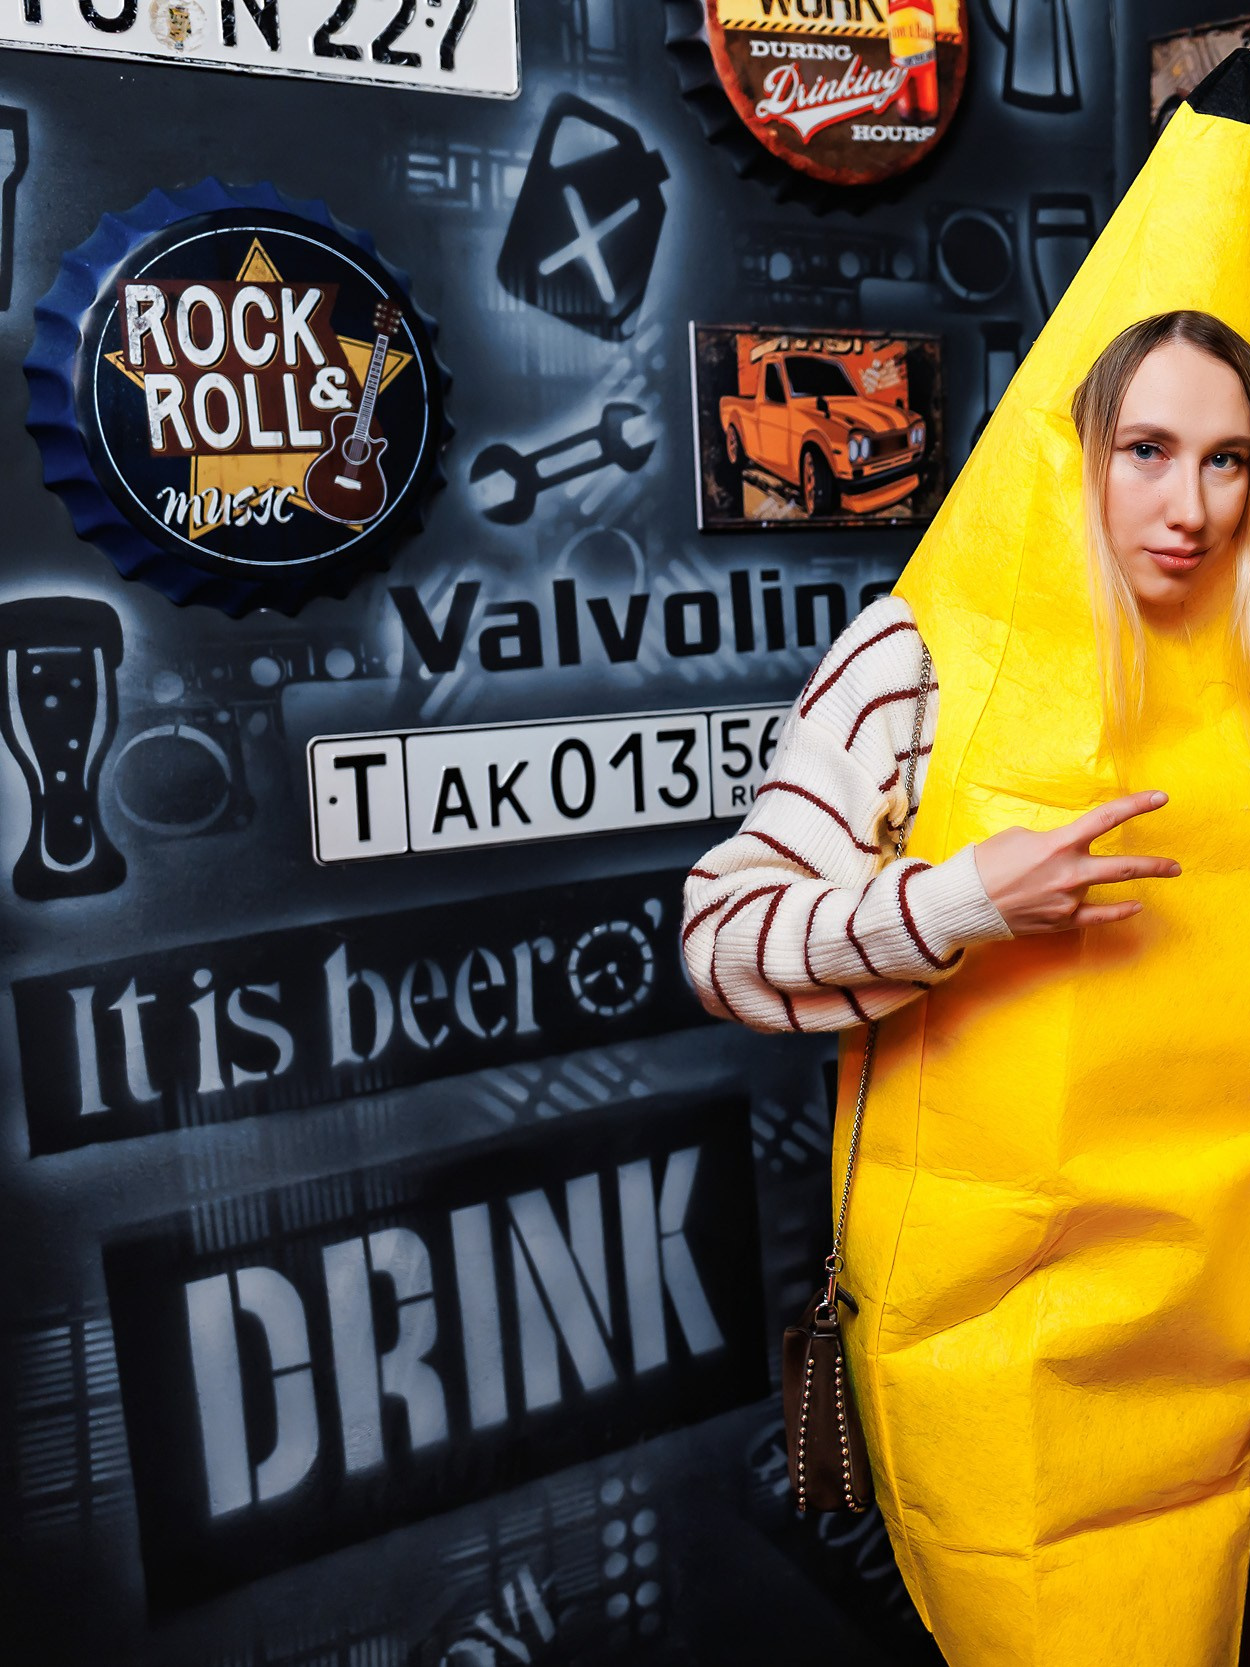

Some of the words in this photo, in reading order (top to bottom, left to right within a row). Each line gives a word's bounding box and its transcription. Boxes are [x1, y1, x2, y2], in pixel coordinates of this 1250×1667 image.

[750, 40, 853, 61] DURING
[755, 55, 908, 118] Drinking
[851, 125, 936, 142] HOURS
[124, 284, 326, 367] ROCK
[144, 373, 324, 449] ROLL
[309, 366, 353, 409] &
[68, 978, 163, 1116] It
[189, 968, 295, 1094] is
[184, 1144, 726, 1520] DRINK
